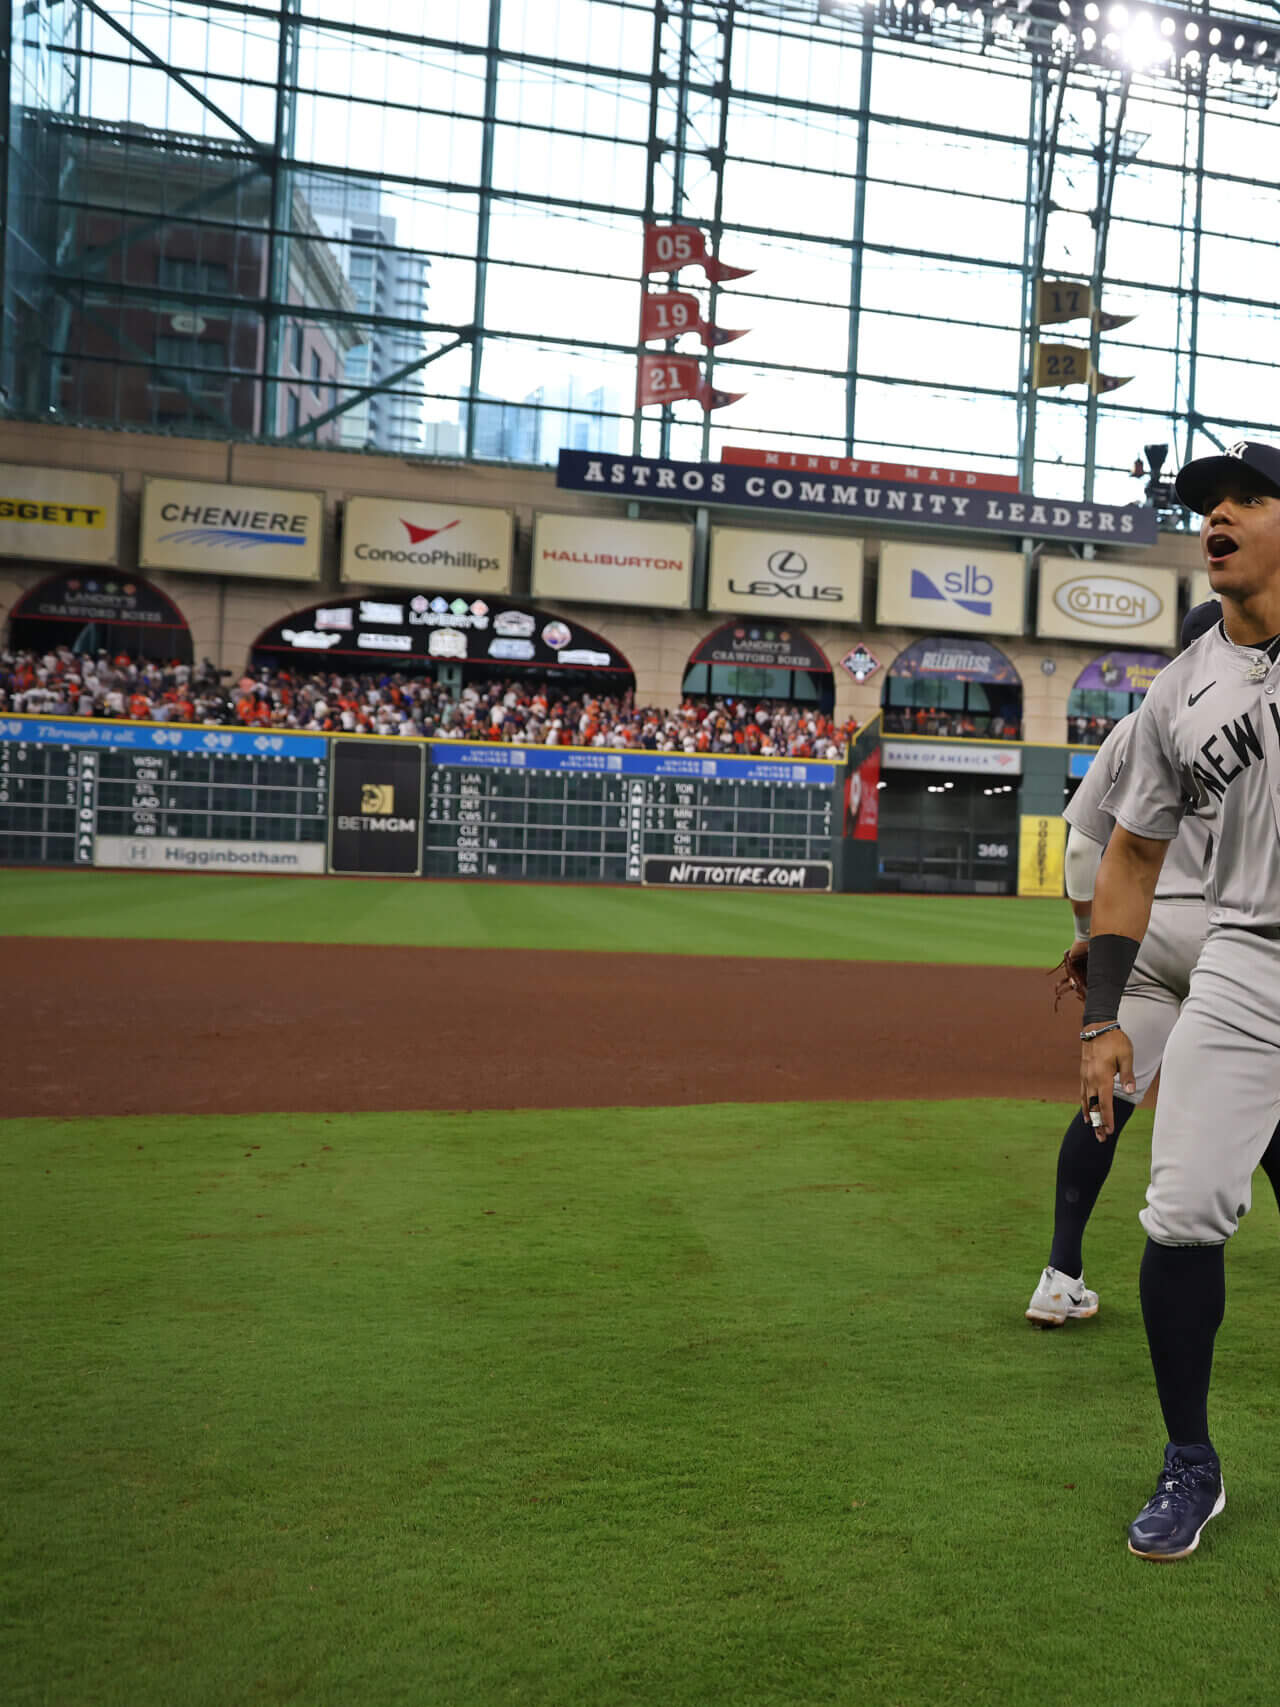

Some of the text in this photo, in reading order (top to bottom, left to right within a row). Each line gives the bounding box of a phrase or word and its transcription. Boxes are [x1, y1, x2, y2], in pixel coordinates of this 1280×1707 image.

[656, 235, 691, 260] 05
[1051, 291, 1079, 313] 17
[656, 304, 687, 327] 19
[1047, 356, 1075, 375] 22
[651, 367, 681, 390] 21
[765, 453, 977, 485] MINUTE MAID
[584, 461, 1134, 534] ASTROS COMMUNITY LEADERS
[160, 503, 309, 533] CHENIERE
[354, 544, 500, 573] ConocoPhillips
[542, 550, 683, 571] HALLIBURTON
[728, 579, 844, 602] LEXUS
[944, 565, 993, 596] slb
[1067, 586, 1146, 619] COTTON
[712, 650, 811, 667] CRAWFORD BOXES
[921, 652, 991, 673] RELENTLESS
[37, 726, 98, 742] Through
[888, 752, 990, 765] BANK OF AMERICA
[1193, 712, 1264, 803] NEW
[80, 756, 95, 860] NATIONAL
[337, 816, 416, 832] BETMGM
[166, 848, 297, 865] Higginbotham
[669, 863, 806, 888] NITTOTIRE.COM
